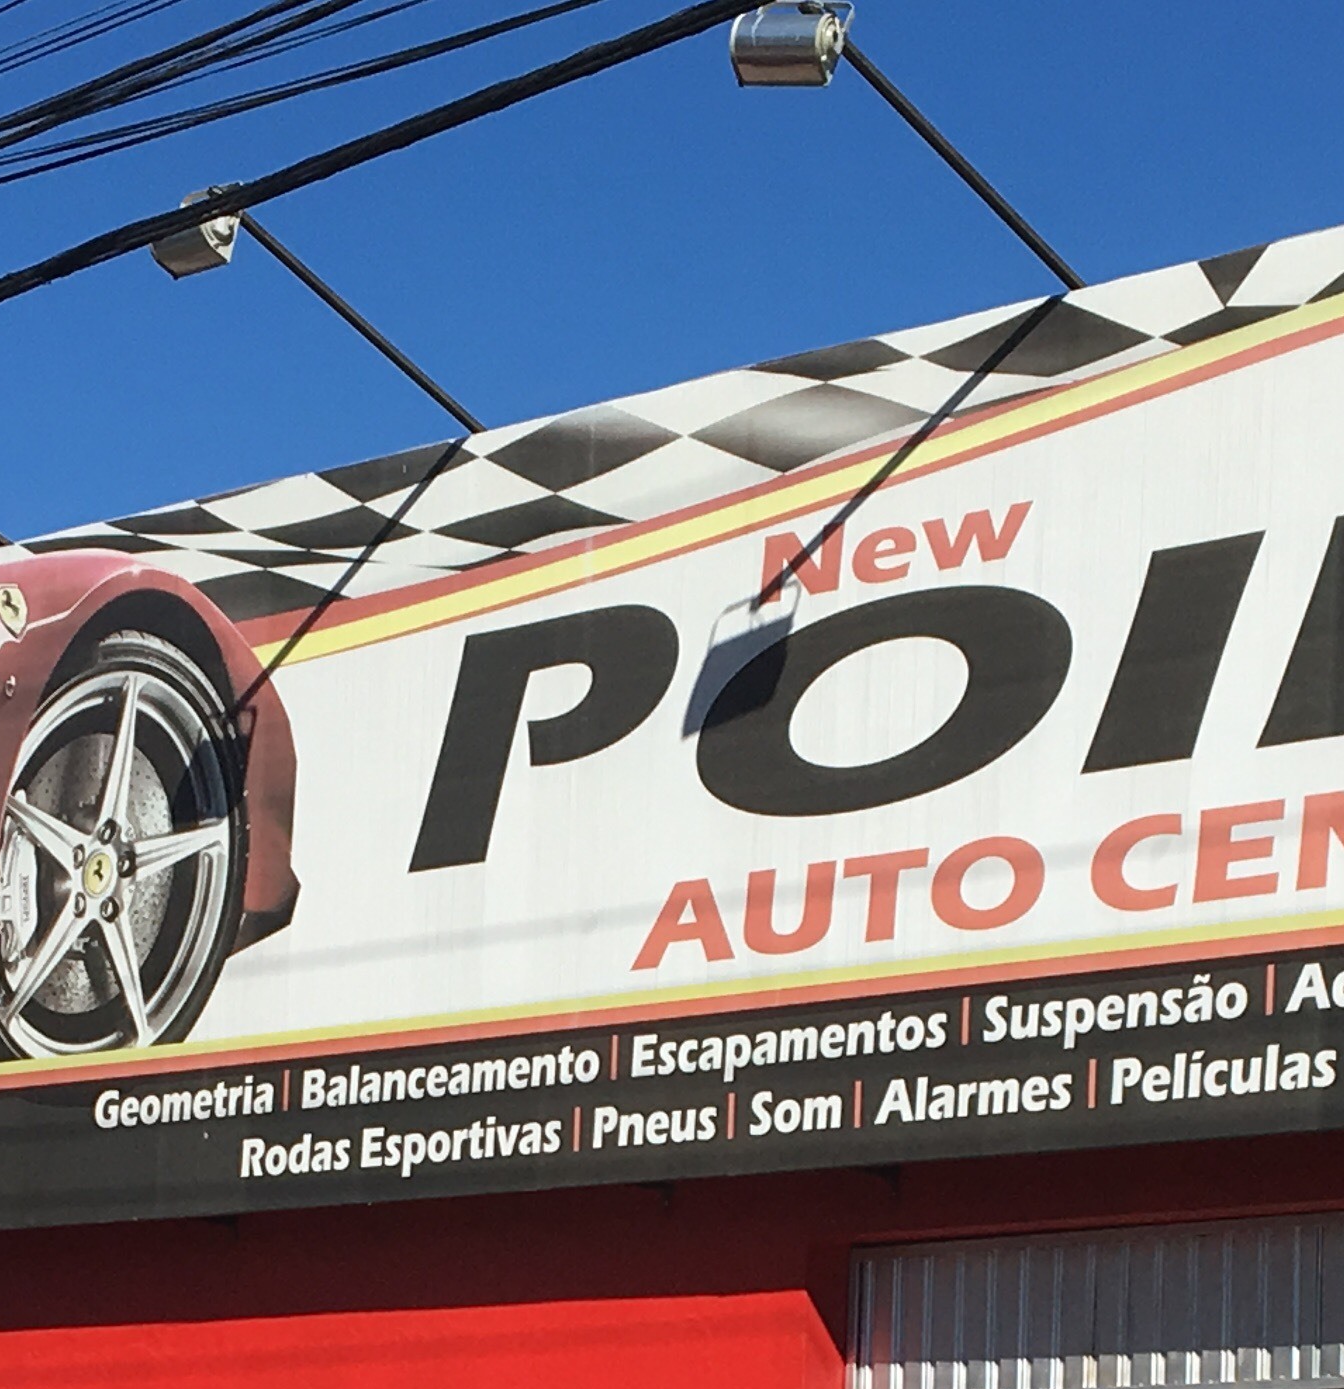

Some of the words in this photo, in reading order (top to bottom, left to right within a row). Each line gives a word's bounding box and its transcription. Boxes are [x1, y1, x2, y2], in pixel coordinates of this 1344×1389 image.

[759, 501, 1033, 603] New
[630, 836, 1045, 971] AUTO
[94, 1077, 274, 1129] Geometria
[301, 1045, 600, 1110] Balanceamento
[631, 1009, 947, 1081] Escapamentos
[983, 976, 1248, 1047] Suspensão
[240, 1132, 350, 1178] Rodas
[360, 1118, 561, 1177] Esportivas
[592, 1103, 717, 1150] Pneus
[749, 1091, 842, 1137] Som
[875, 1074, 1073, 1125] Alarmes
[1110, 1045, 1337, 1105] Películas
